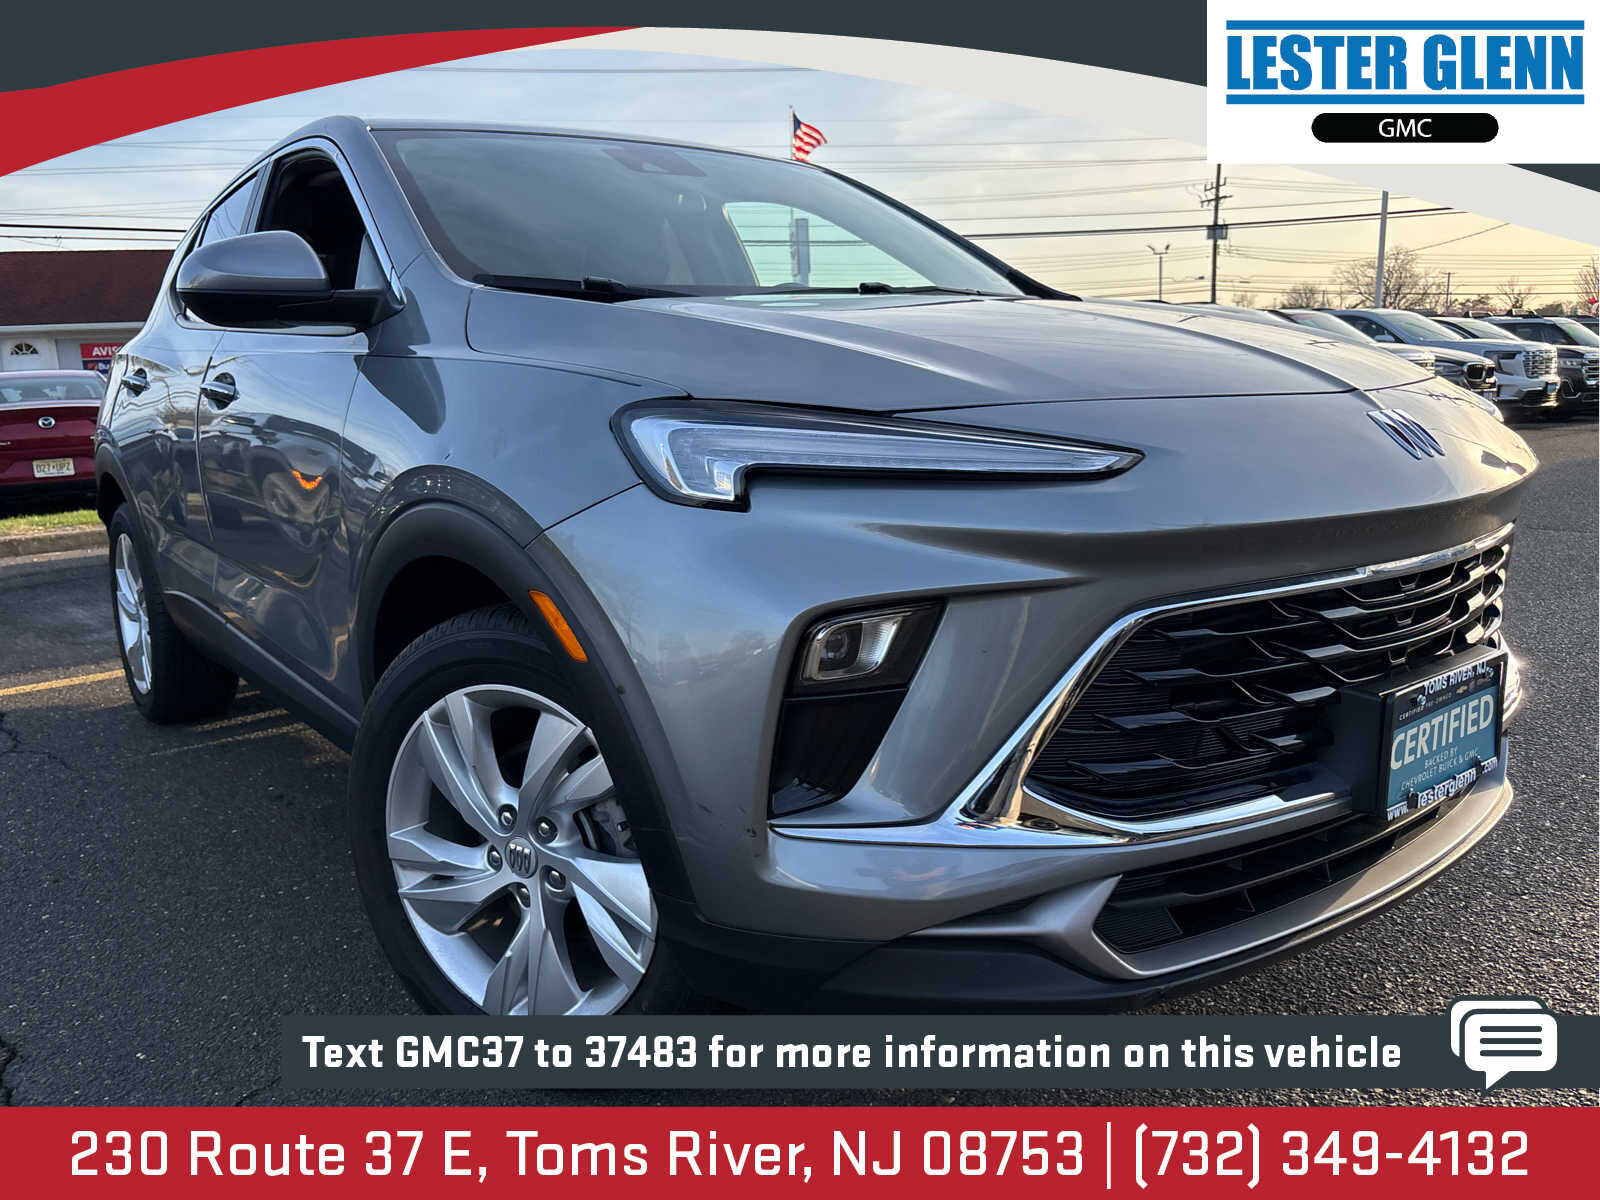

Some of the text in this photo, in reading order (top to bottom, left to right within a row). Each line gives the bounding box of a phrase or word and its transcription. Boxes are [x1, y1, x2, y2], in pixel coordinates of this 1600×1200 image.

[1424, 660, 1487, 695] TOMS RIVER, NJ
[1390, 694, 1494, 770] CERTIFIED
[1401, 766, 1437, 791] CHEVROLET
[1438, 758, 1457, 774] BUICK
[1424, 746, 1458, 769] BACKED BY
